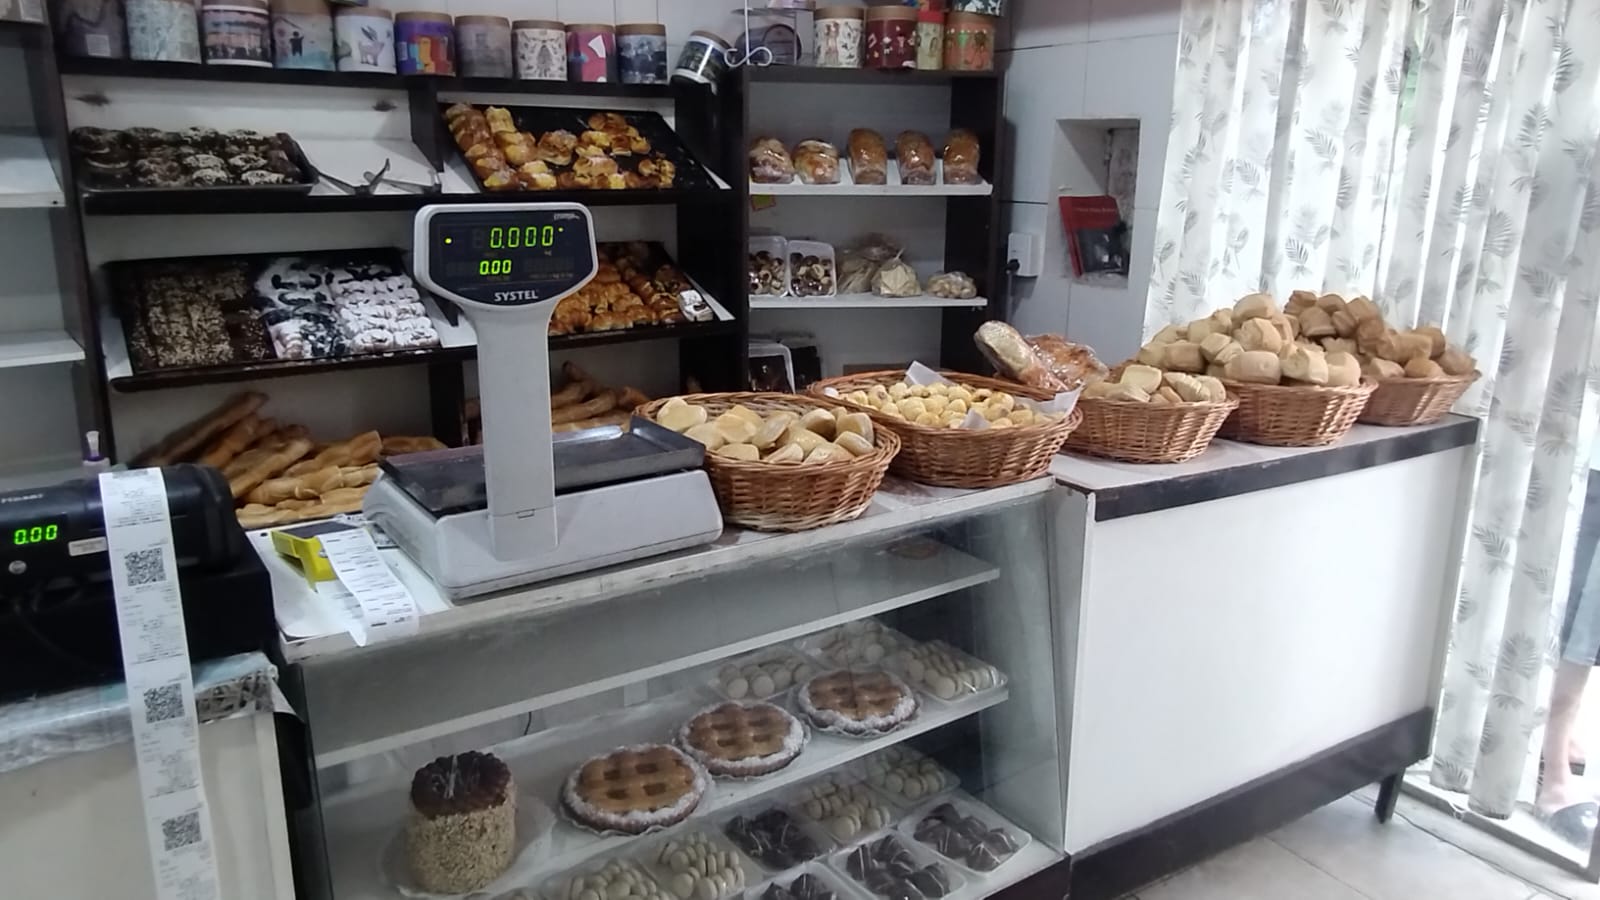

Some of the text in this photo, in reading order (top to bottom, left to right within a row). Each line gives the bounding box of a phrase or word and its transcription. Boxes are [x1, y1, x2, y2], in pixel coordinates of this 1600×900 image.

[490, 225, 554, 248] 0.000
[479, 259, 512, 275] 0.00
[494, 290, 539, 302] SYSTEL
[14, 524, 58, 545] 0.00
